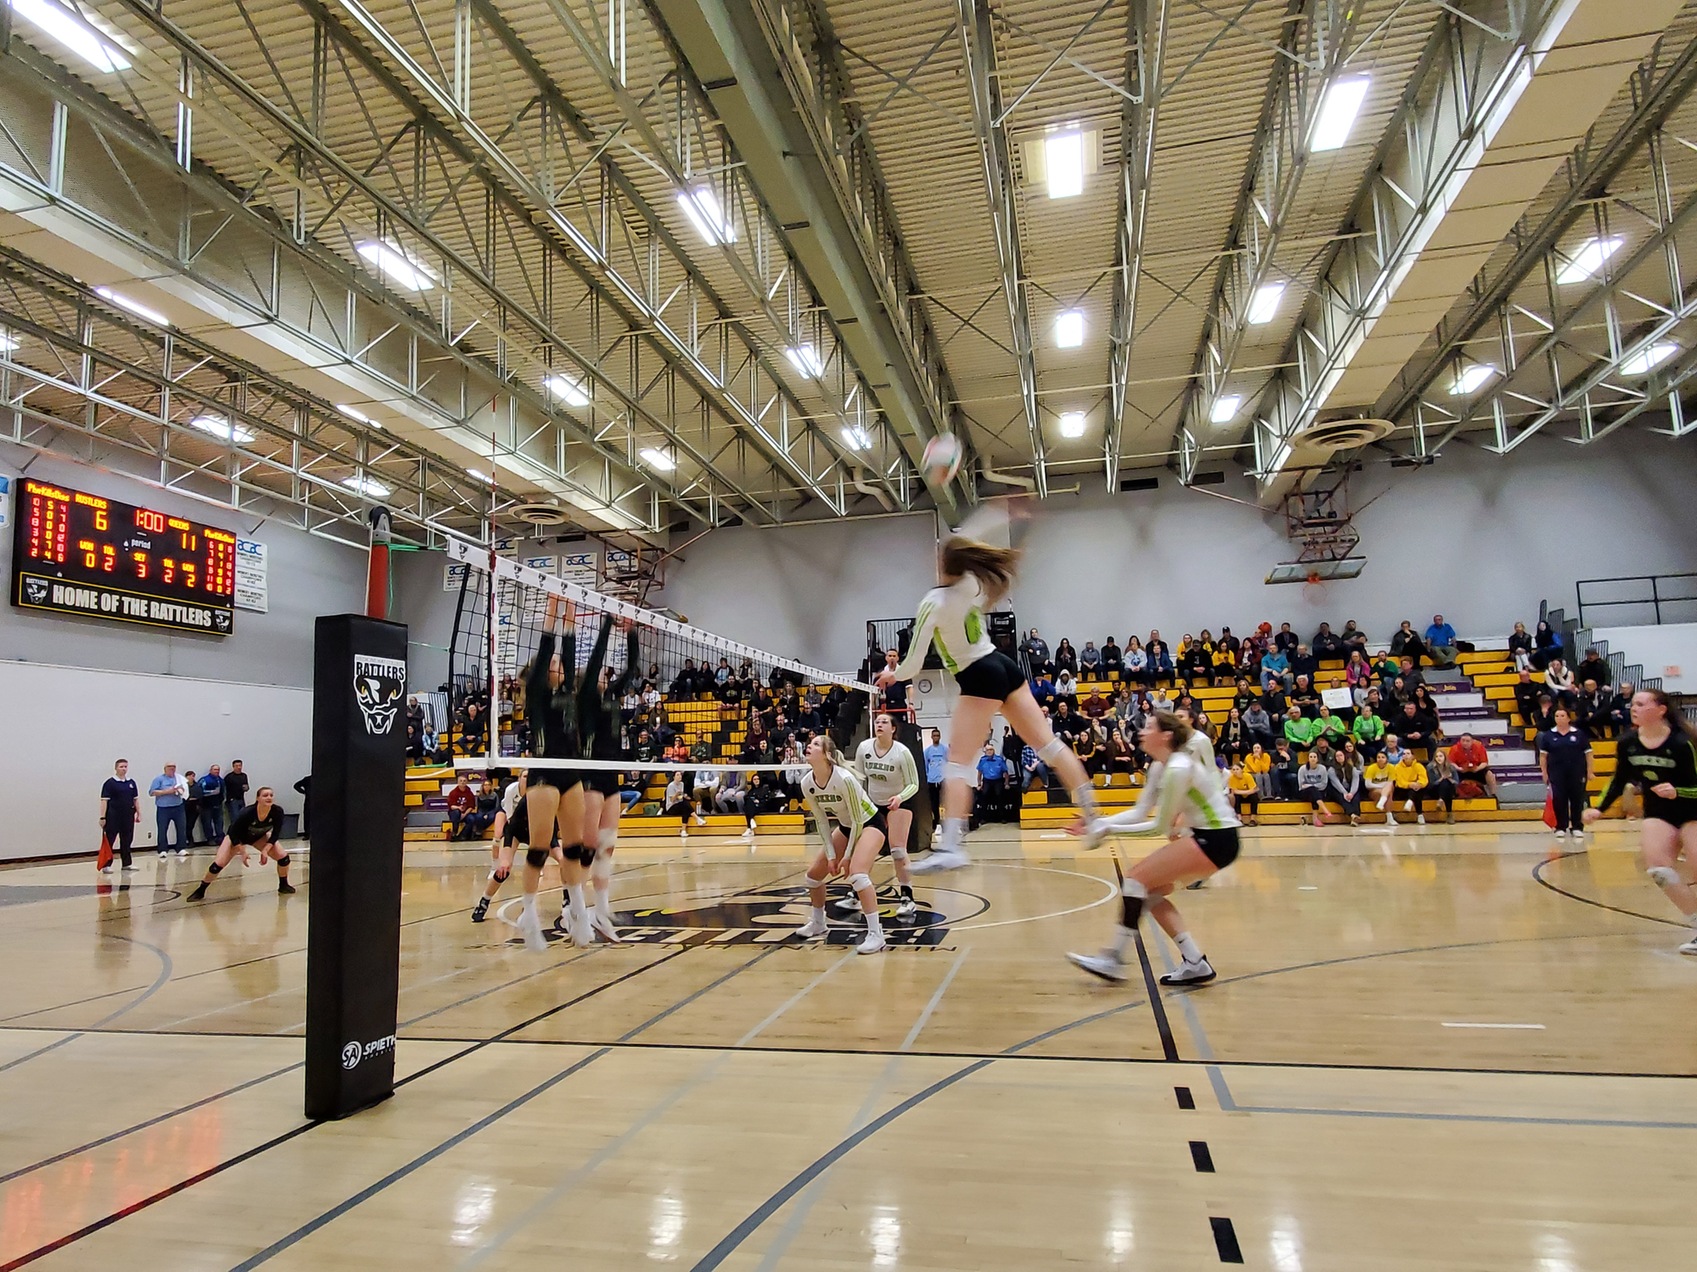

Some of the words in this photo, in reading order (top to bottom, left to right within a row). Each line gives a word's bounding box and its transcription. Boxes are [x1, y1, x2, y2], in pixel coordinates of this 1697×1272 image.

[96, 510, 107, 530] 6
[136, 510, 164, 532] 1:00
[131, 538, 151, 550] period
[182, 532, 196, 551] 11
[86, 553, 95, 568] 0
[104, 557, 113, 572] 2
[138, 564, 146, 578] 3
[164, 570, 172, 583] 2
[187, 574, 195, 588] 2
[53, 584, 98, 610] HOME
[100, 592, 120, 612] OF
[121, 596, 148, 617] THE
[150, 600, 212, 627] RATTLERS
[356, 662, 404, 680] RATTLERS
